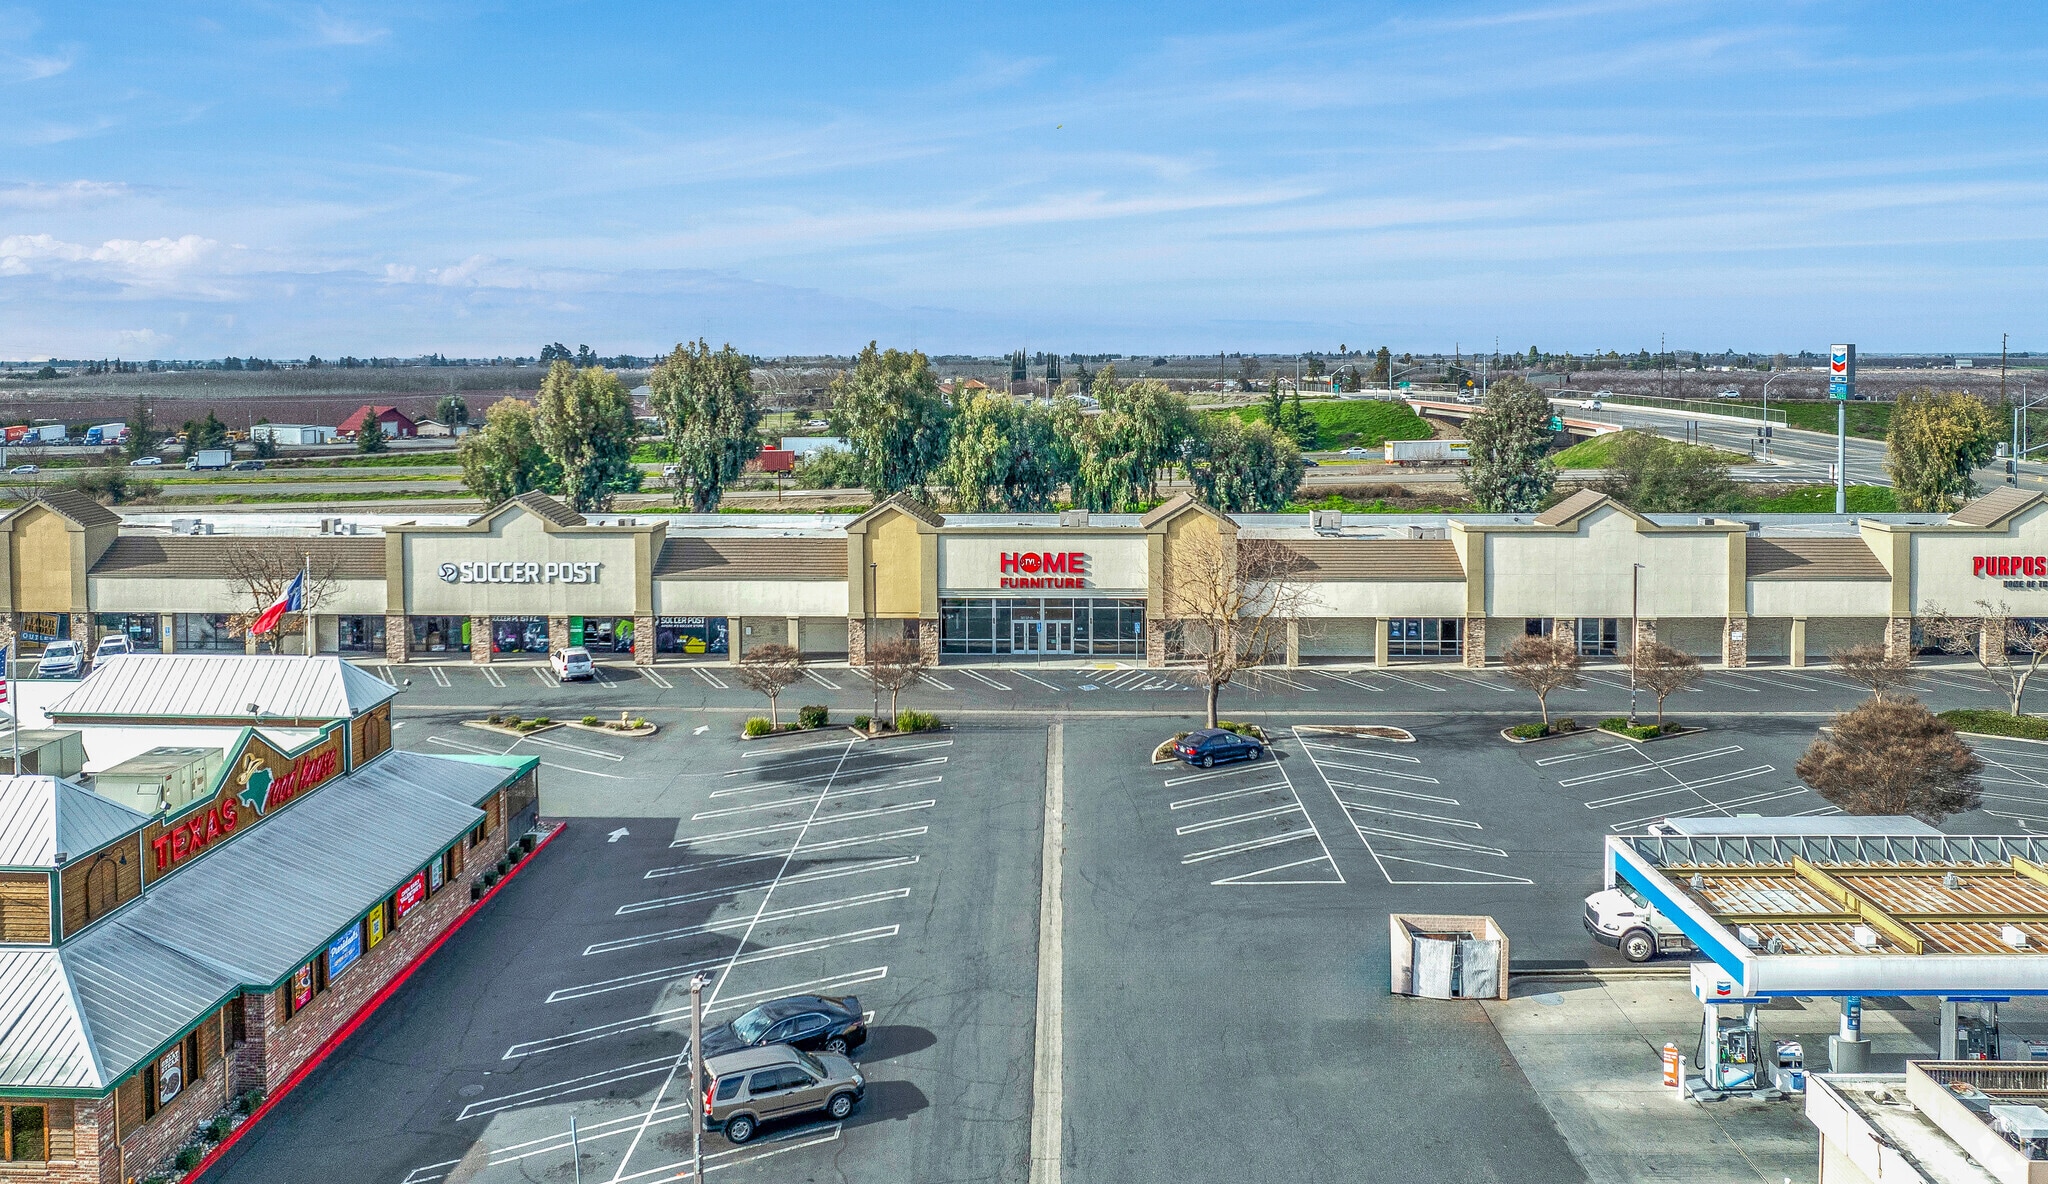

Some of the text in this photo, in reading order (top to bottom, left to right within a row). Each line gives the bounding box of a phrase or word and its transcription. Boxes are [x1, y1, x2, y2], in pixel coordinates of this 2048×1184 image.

[459, 562, 601, 583] SOCCER POST
[1000, 552, 1085, 573] HOME
[1972, 556, 2047, 576] PURPOS
[1000, 577, 1085, 589] FURNITURE
[2003, 580, 2025, 588] HOME
[2026, 580, 2036, 588] OF
[687, 616, 705, 624] POST
[152, 798, 239, 871] TEXAS
